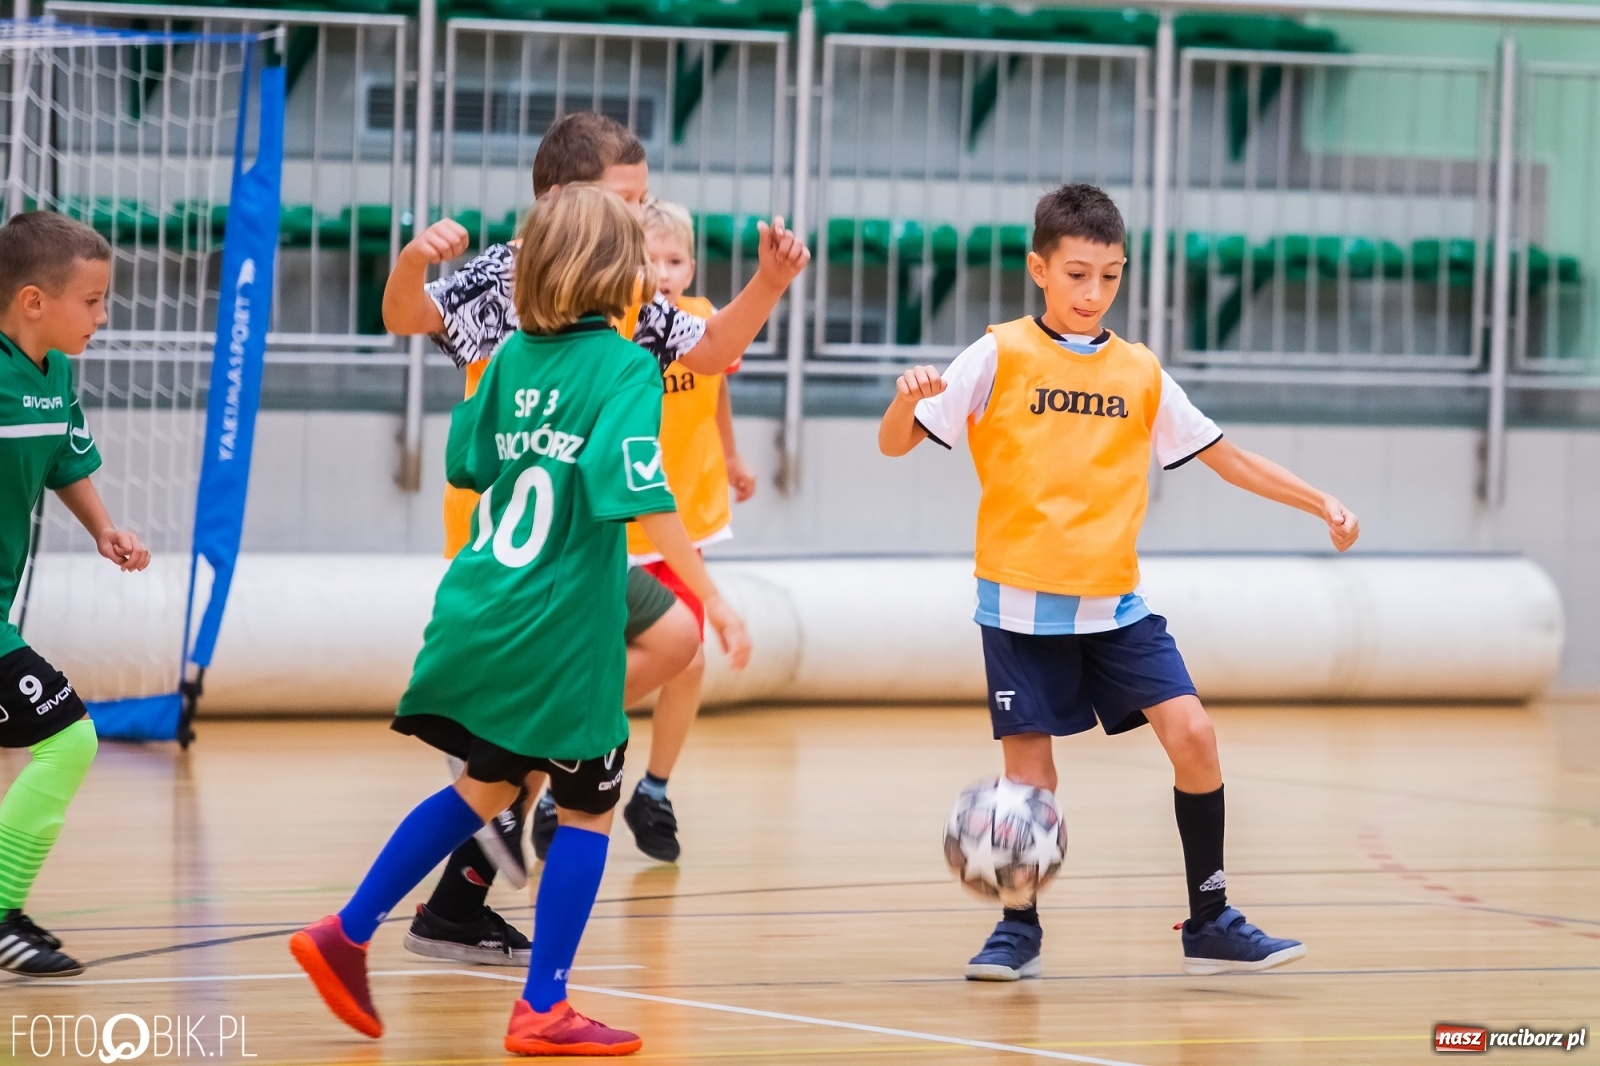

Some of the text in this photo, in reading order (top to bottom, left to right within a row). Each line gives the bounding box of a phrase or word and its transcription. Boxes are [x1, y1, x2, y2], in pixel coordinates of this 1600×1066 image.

[218, 296, 250, 462] YAKIMASPORT
[22, 394, 63, 410] GIVOVA
[514, 388, 560, 418] SP 3
[472, 466, 554, 568] 10
[18, 674, 43, 704] 9
[36, 680, 73, 716] GIVOV
